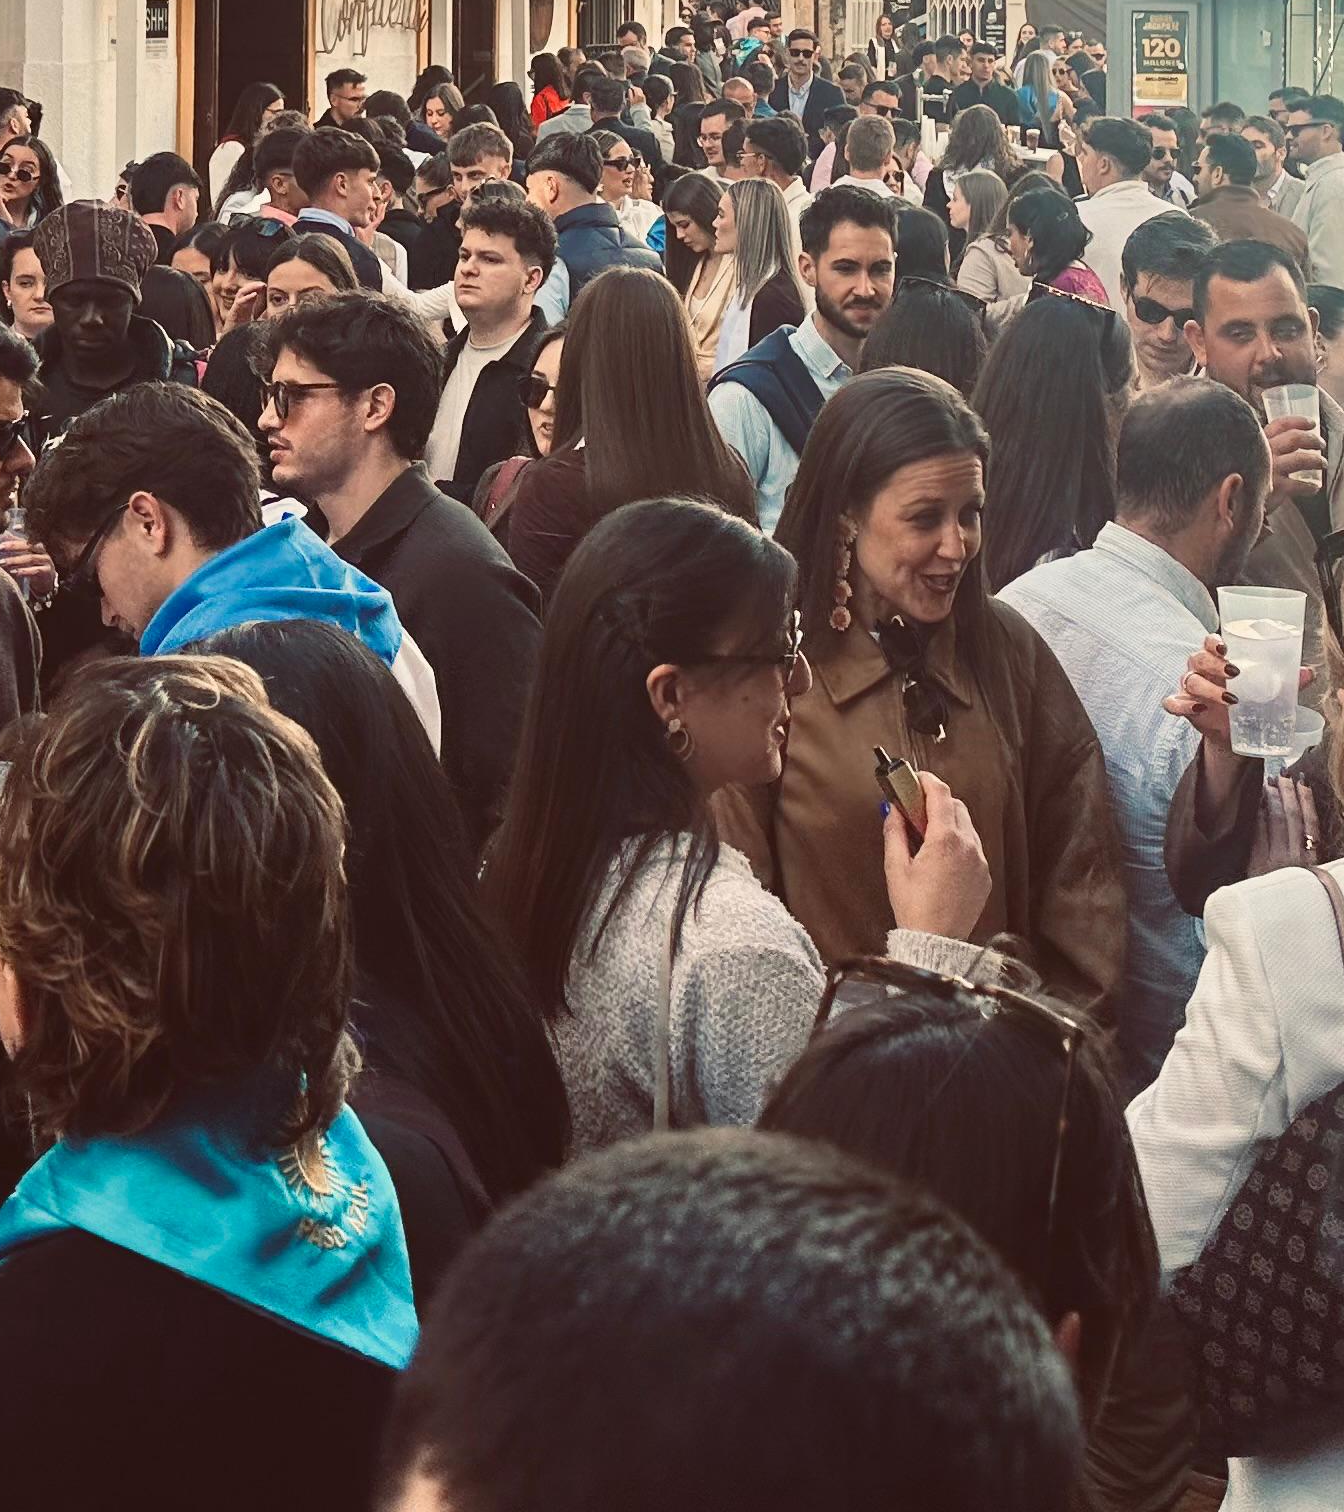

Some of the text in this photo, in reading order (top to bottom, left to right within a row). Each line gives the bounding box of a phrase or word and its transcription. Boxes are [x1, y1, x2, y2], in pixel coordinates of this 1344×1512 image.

[145, 7, 168, 32] SHH!
[1141, 38, 1182, 58] 120
[297, 1179, 369, 1250] PASO AZUL
